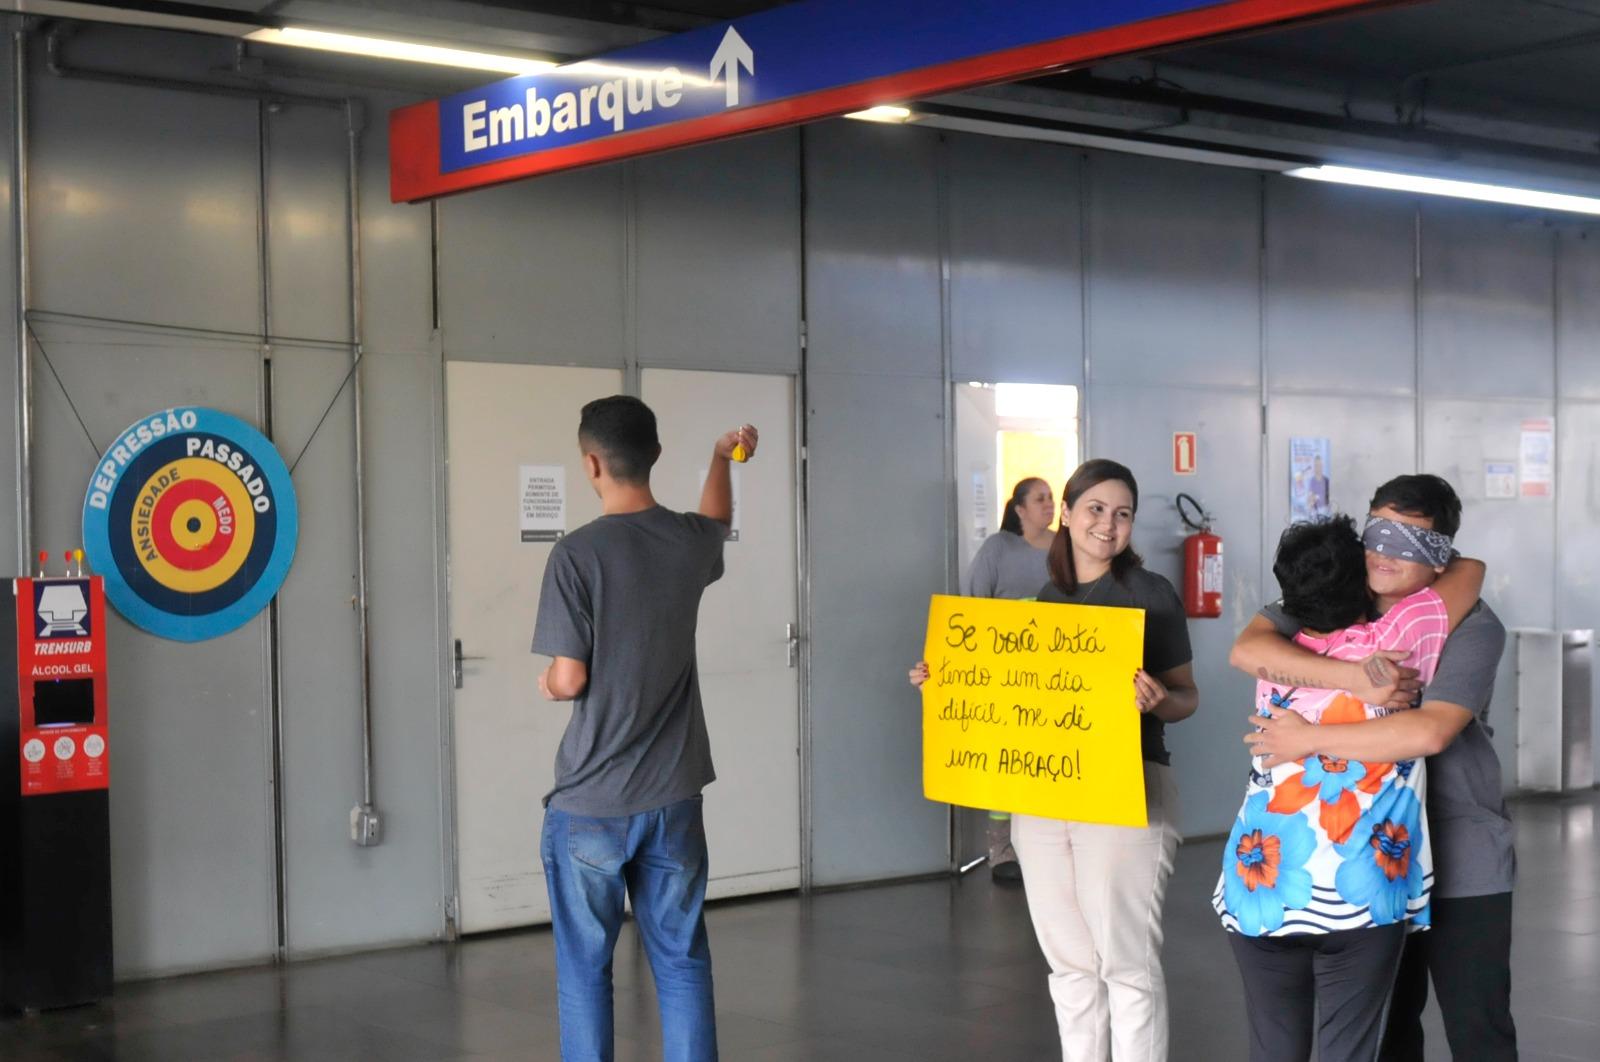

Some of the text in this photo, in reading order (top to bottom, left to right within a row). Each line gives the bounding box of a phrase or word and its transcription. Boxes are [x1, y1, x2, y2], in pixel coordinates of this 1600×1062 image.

[462, 66, 684, 154] Embarque
[89, 408, 198, 511] DEPRESSÃO
[186, 437, 271, 514] PASSADO
[136, 466, 181, 563] ANSIEDADE
[212, 495, 232, 536] MEDO
[34, 640, 92, 656] TRENSURB
[945, 612, 1106, 655] Se você está
[73, 663, 94, 674] GEL
[937, 655, 1092, 693] tendo um dia
[1012, 703, 1048, 728] me
[1054, 703, 1092, 731] dê
[945, 748, 1082, 782] um ABRAÇO!
